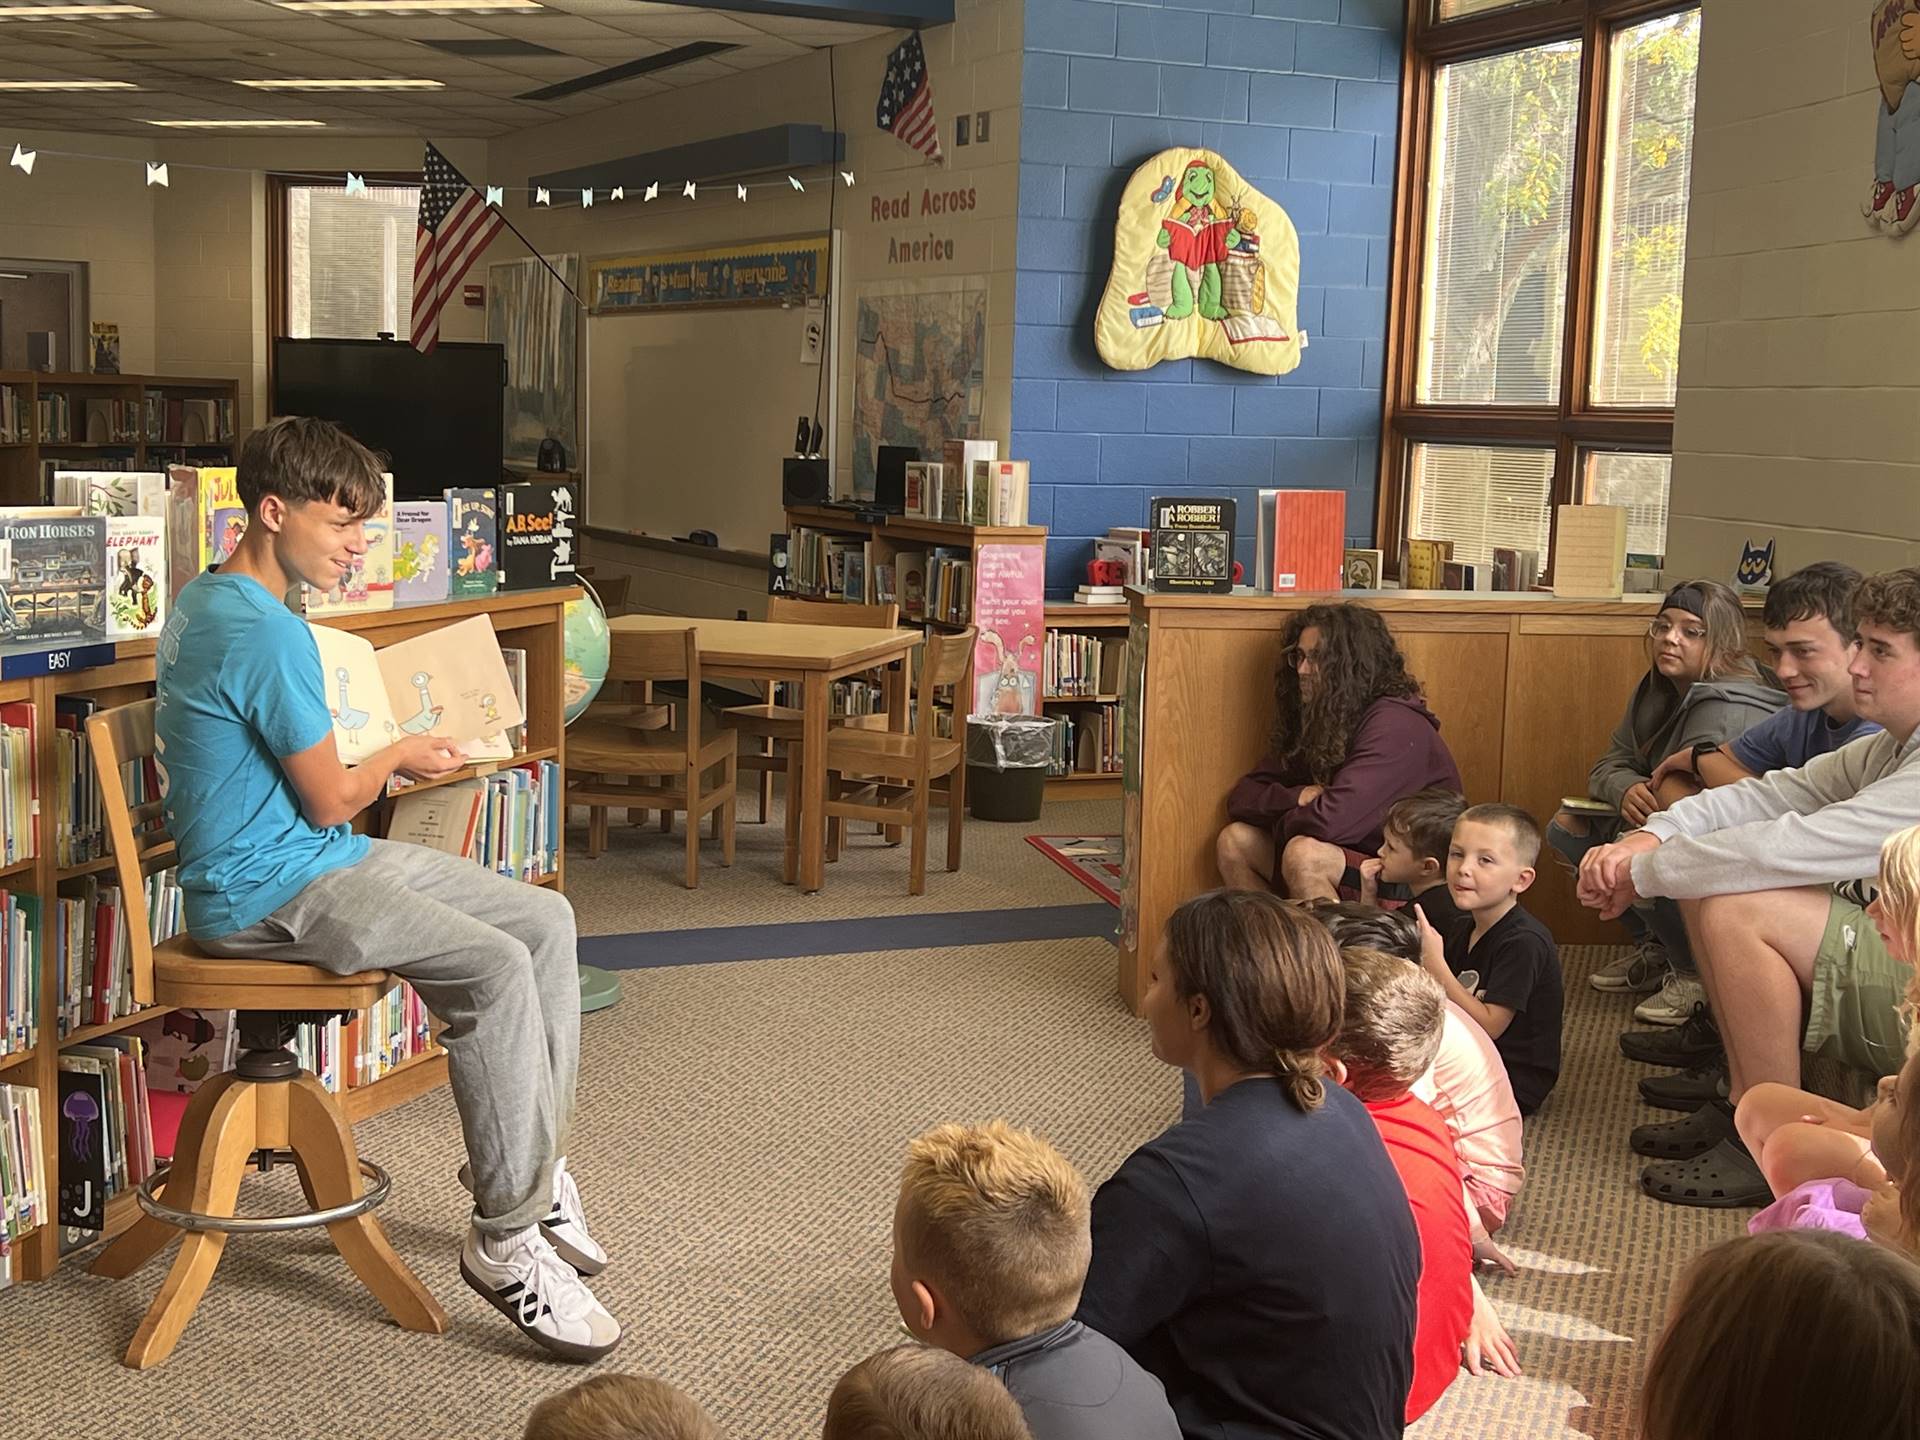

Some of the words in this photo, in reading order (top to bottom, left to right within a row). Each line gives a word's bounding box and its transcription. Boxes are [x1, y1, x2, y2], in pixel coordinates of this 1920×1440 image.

[871, 190, 910, 222] Read
[921, 188, 976, 216] Across
[888, 232, 954, 264] America
[607, 275, 642, 294] Reading
[1169, 505, 1176, 514] A
[4, 525, 38, 540] IRON
[40, 524, 95, 539] HORSES
[512, 536, 530, 545] TANA
[530, 534, 553, 544] HOBAN
[106, 536, 159, 548] ELEPHANT
[773, 575, 785, 591] A
[48, 651, 71, 670] EASY
[73, 1180, 91, 1217] J
